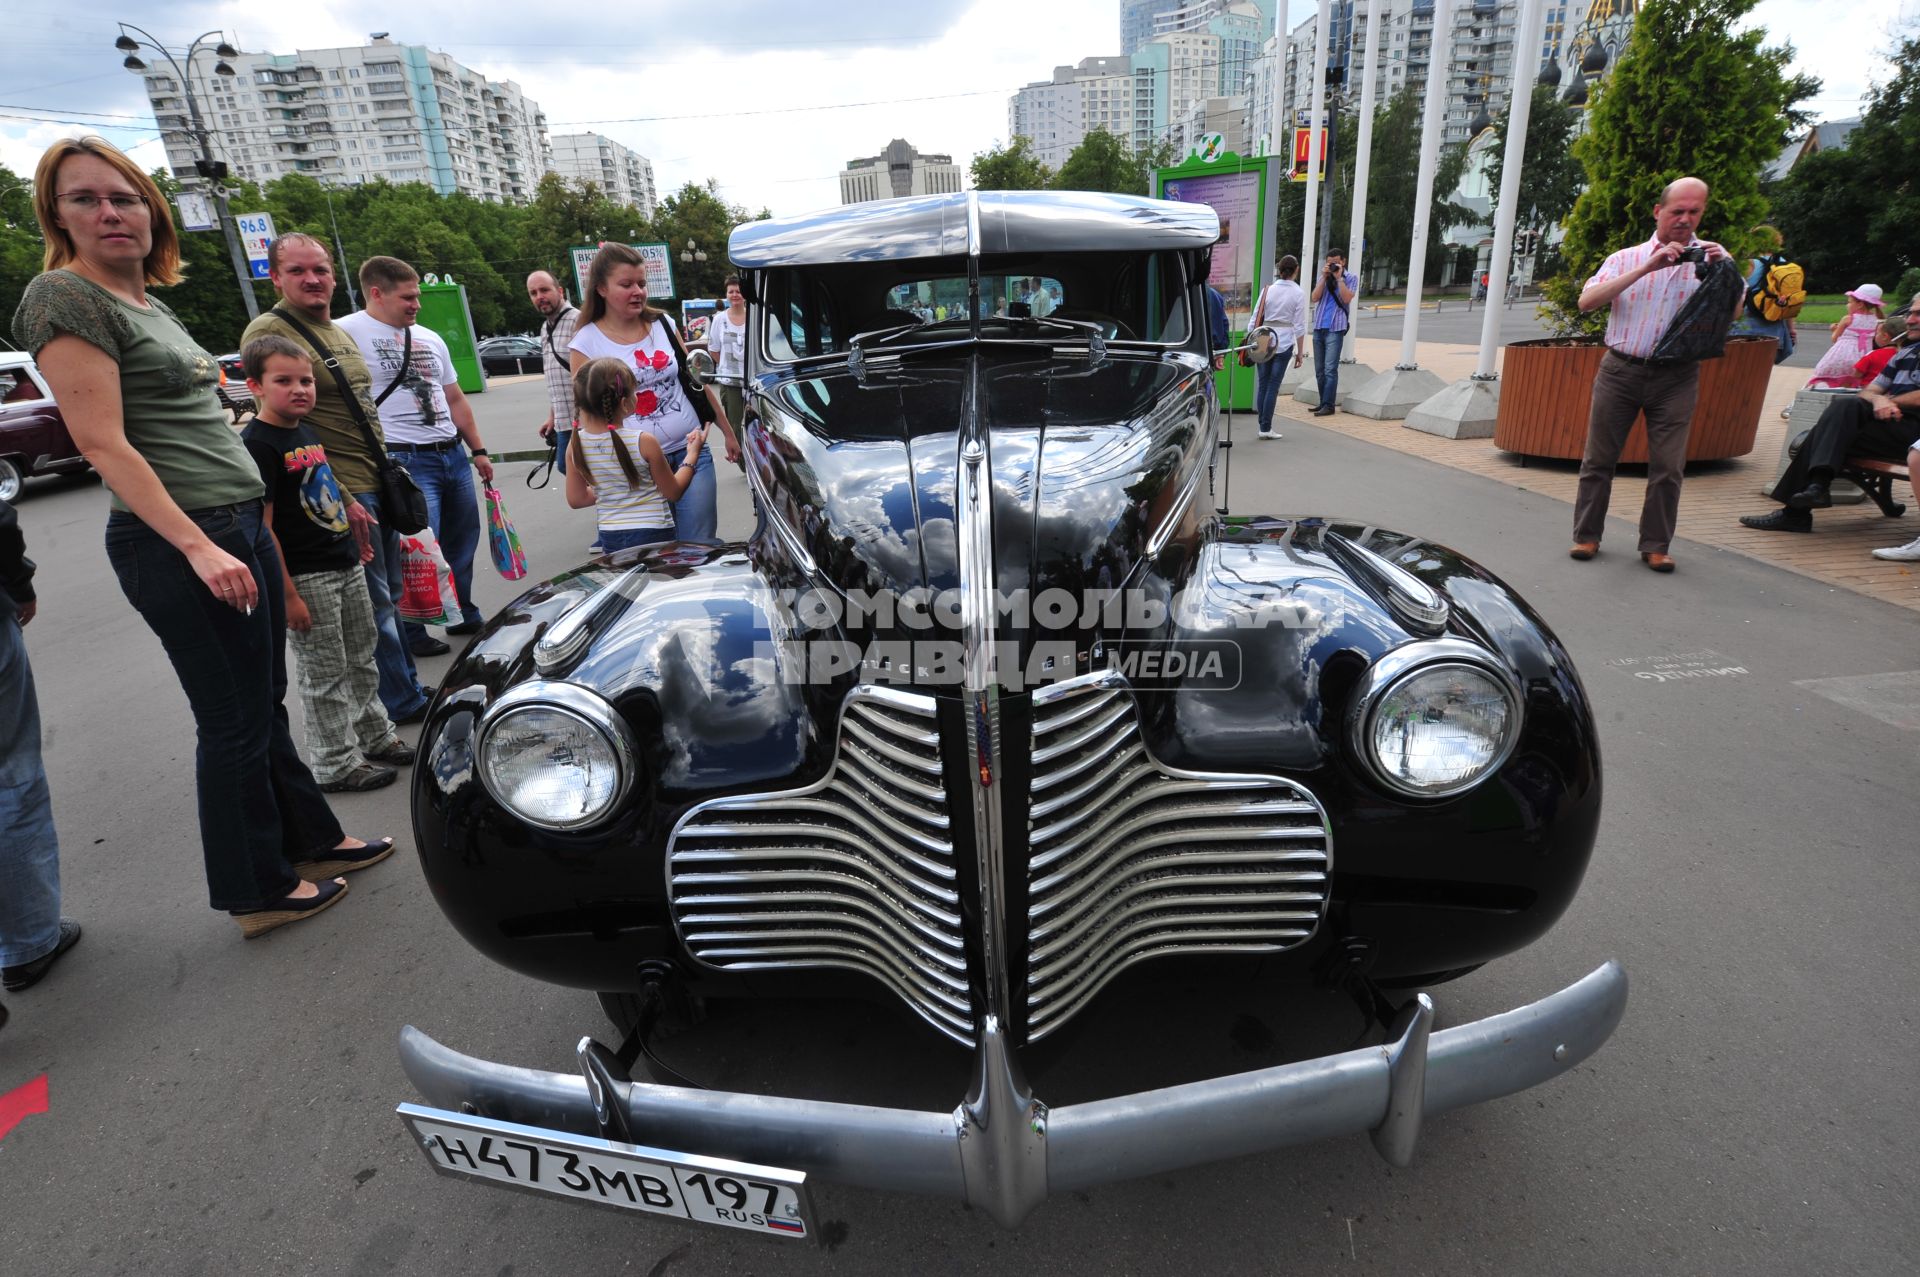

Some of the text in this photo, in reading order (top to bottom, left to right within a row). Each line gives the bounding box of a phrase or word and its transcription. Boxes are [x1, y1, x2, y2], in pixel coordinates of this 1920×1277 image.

[240, 218, 267, 233] 96.8
[434, 1136, 779, 1215] Н473МВ 197
[715, 1206, 765, 1226] RUS
